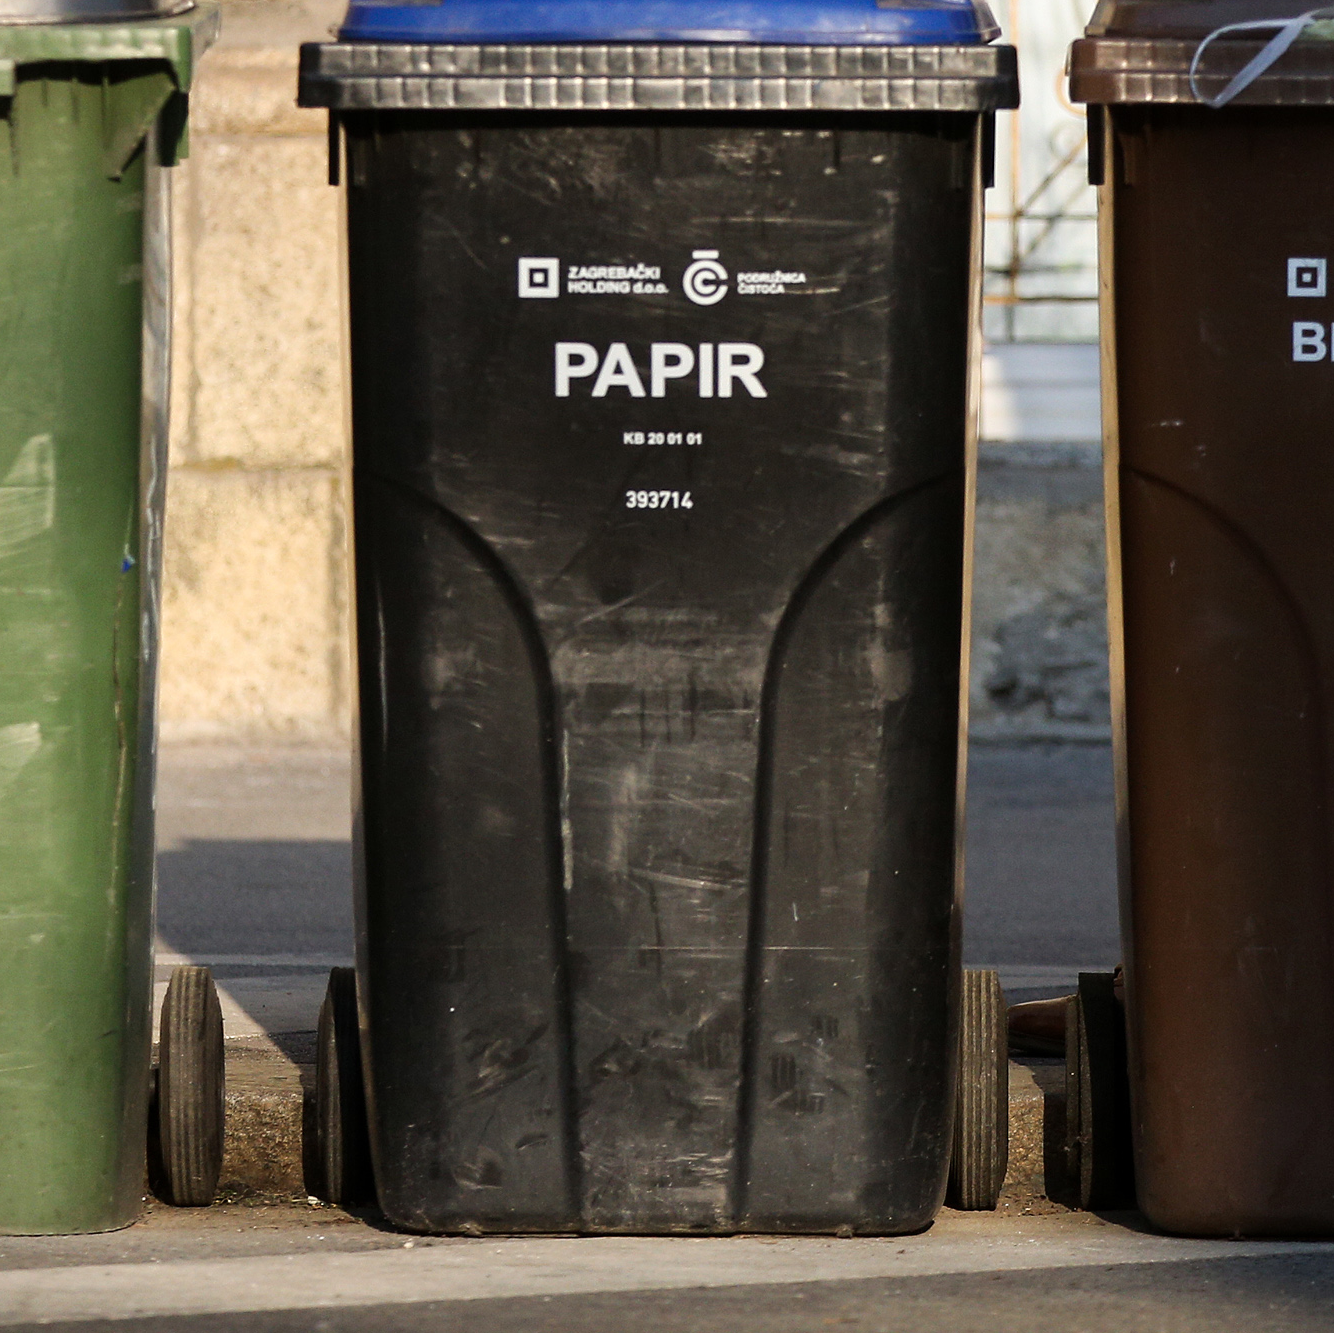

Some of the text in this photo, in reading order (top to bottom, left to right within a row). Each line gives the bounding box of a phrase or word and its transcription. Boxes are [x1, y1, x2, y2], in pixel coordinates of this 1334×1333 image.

[568, 262, 661, 279] ZAGREBAČKI
[568, 280, 631, 294] HOLDING
[554, 342, 768, 399] PAPIR
[623, 431, 702, 445] KB 20 01 01
[625, 490, 694, 509] 393714
